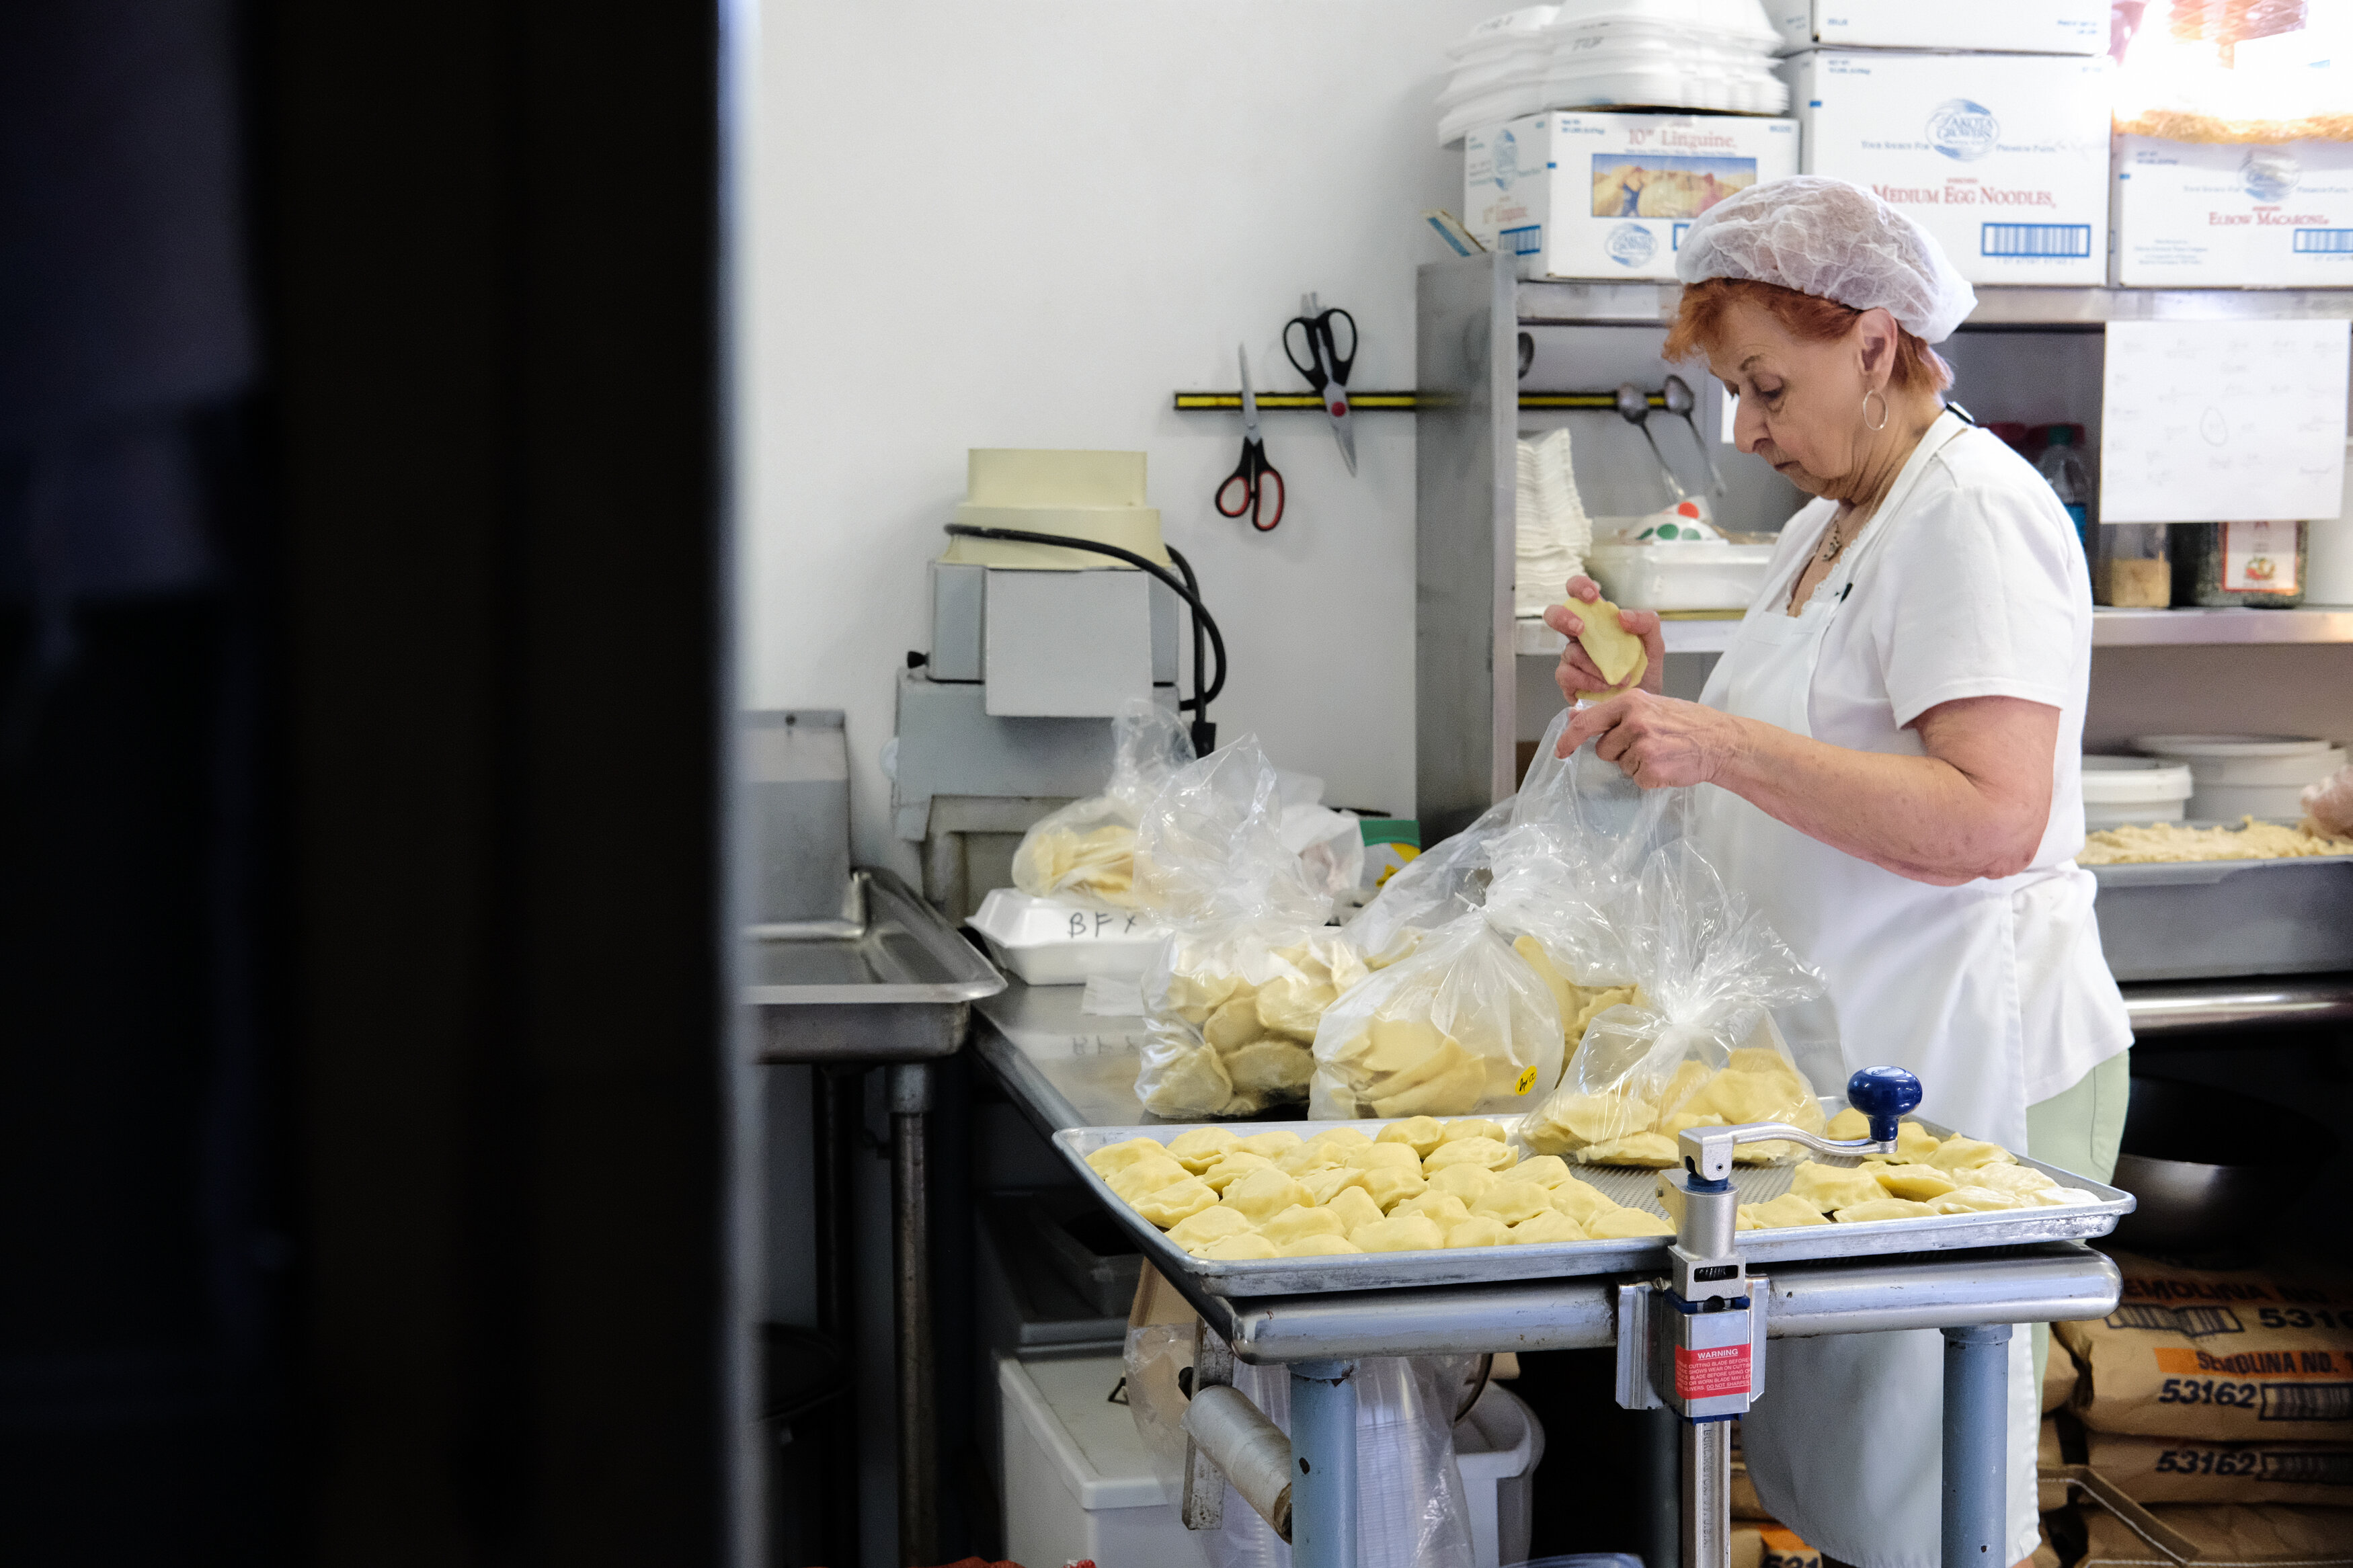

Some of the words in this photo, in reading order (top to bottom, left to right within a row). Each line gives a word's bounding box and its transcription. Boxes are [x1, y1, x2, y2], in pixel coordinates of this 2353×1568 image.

[2122, 1279, 2272, 1301] EMOLINA
[1698, 1348, 1739, 1359] WARNING
[2196, 1350, 2297, 1374] SEMOLINA
[2158, 1379, 2257, 1408] 53162
[2155, 1450, 2257, 1476] 53162
